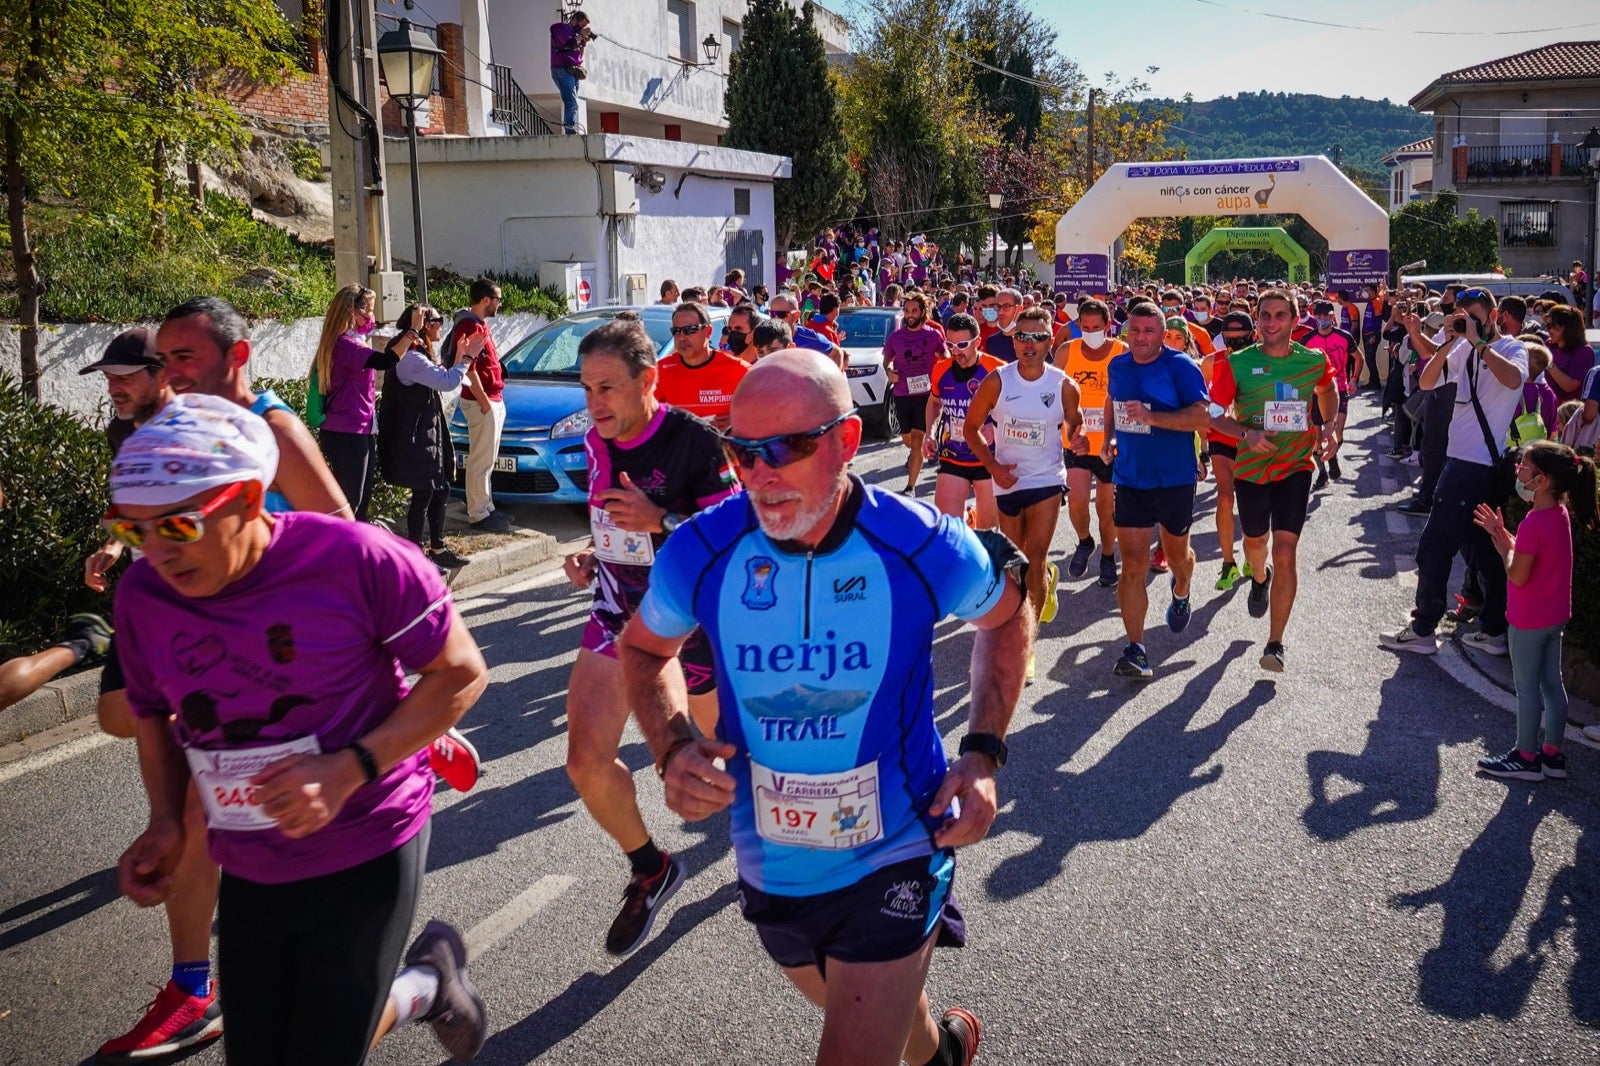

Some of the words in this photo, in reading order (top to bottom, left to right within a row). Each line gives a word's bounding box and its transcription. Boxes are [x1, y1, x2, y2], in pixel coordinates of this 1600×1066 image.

[1184, 165, 1204, 175] VIDA
[1193, 186, 1212, 196] con
[1214, 184, 1250, 195] cáncer
[1216, 195, 1252, 211] aupa
[1226, 231, 1270, 239] Diputación
[1072, 371, 1098, 385] 525
[1274, 402, 1280, 410] V
[1272, 415, 1289, 424] 104
[1006, 428, 1028, 439] 1160
[602, 534, 610, 548] 3
[834, 593, 867, 603] SURAL
[735, 630, 872, 681] nerja
[758, 714, 847, 742] TRAIL
[771, 773, 786, 793] V
[786, 786, 839, 796] CARRERA
[770, 806, 818, 830] 197
